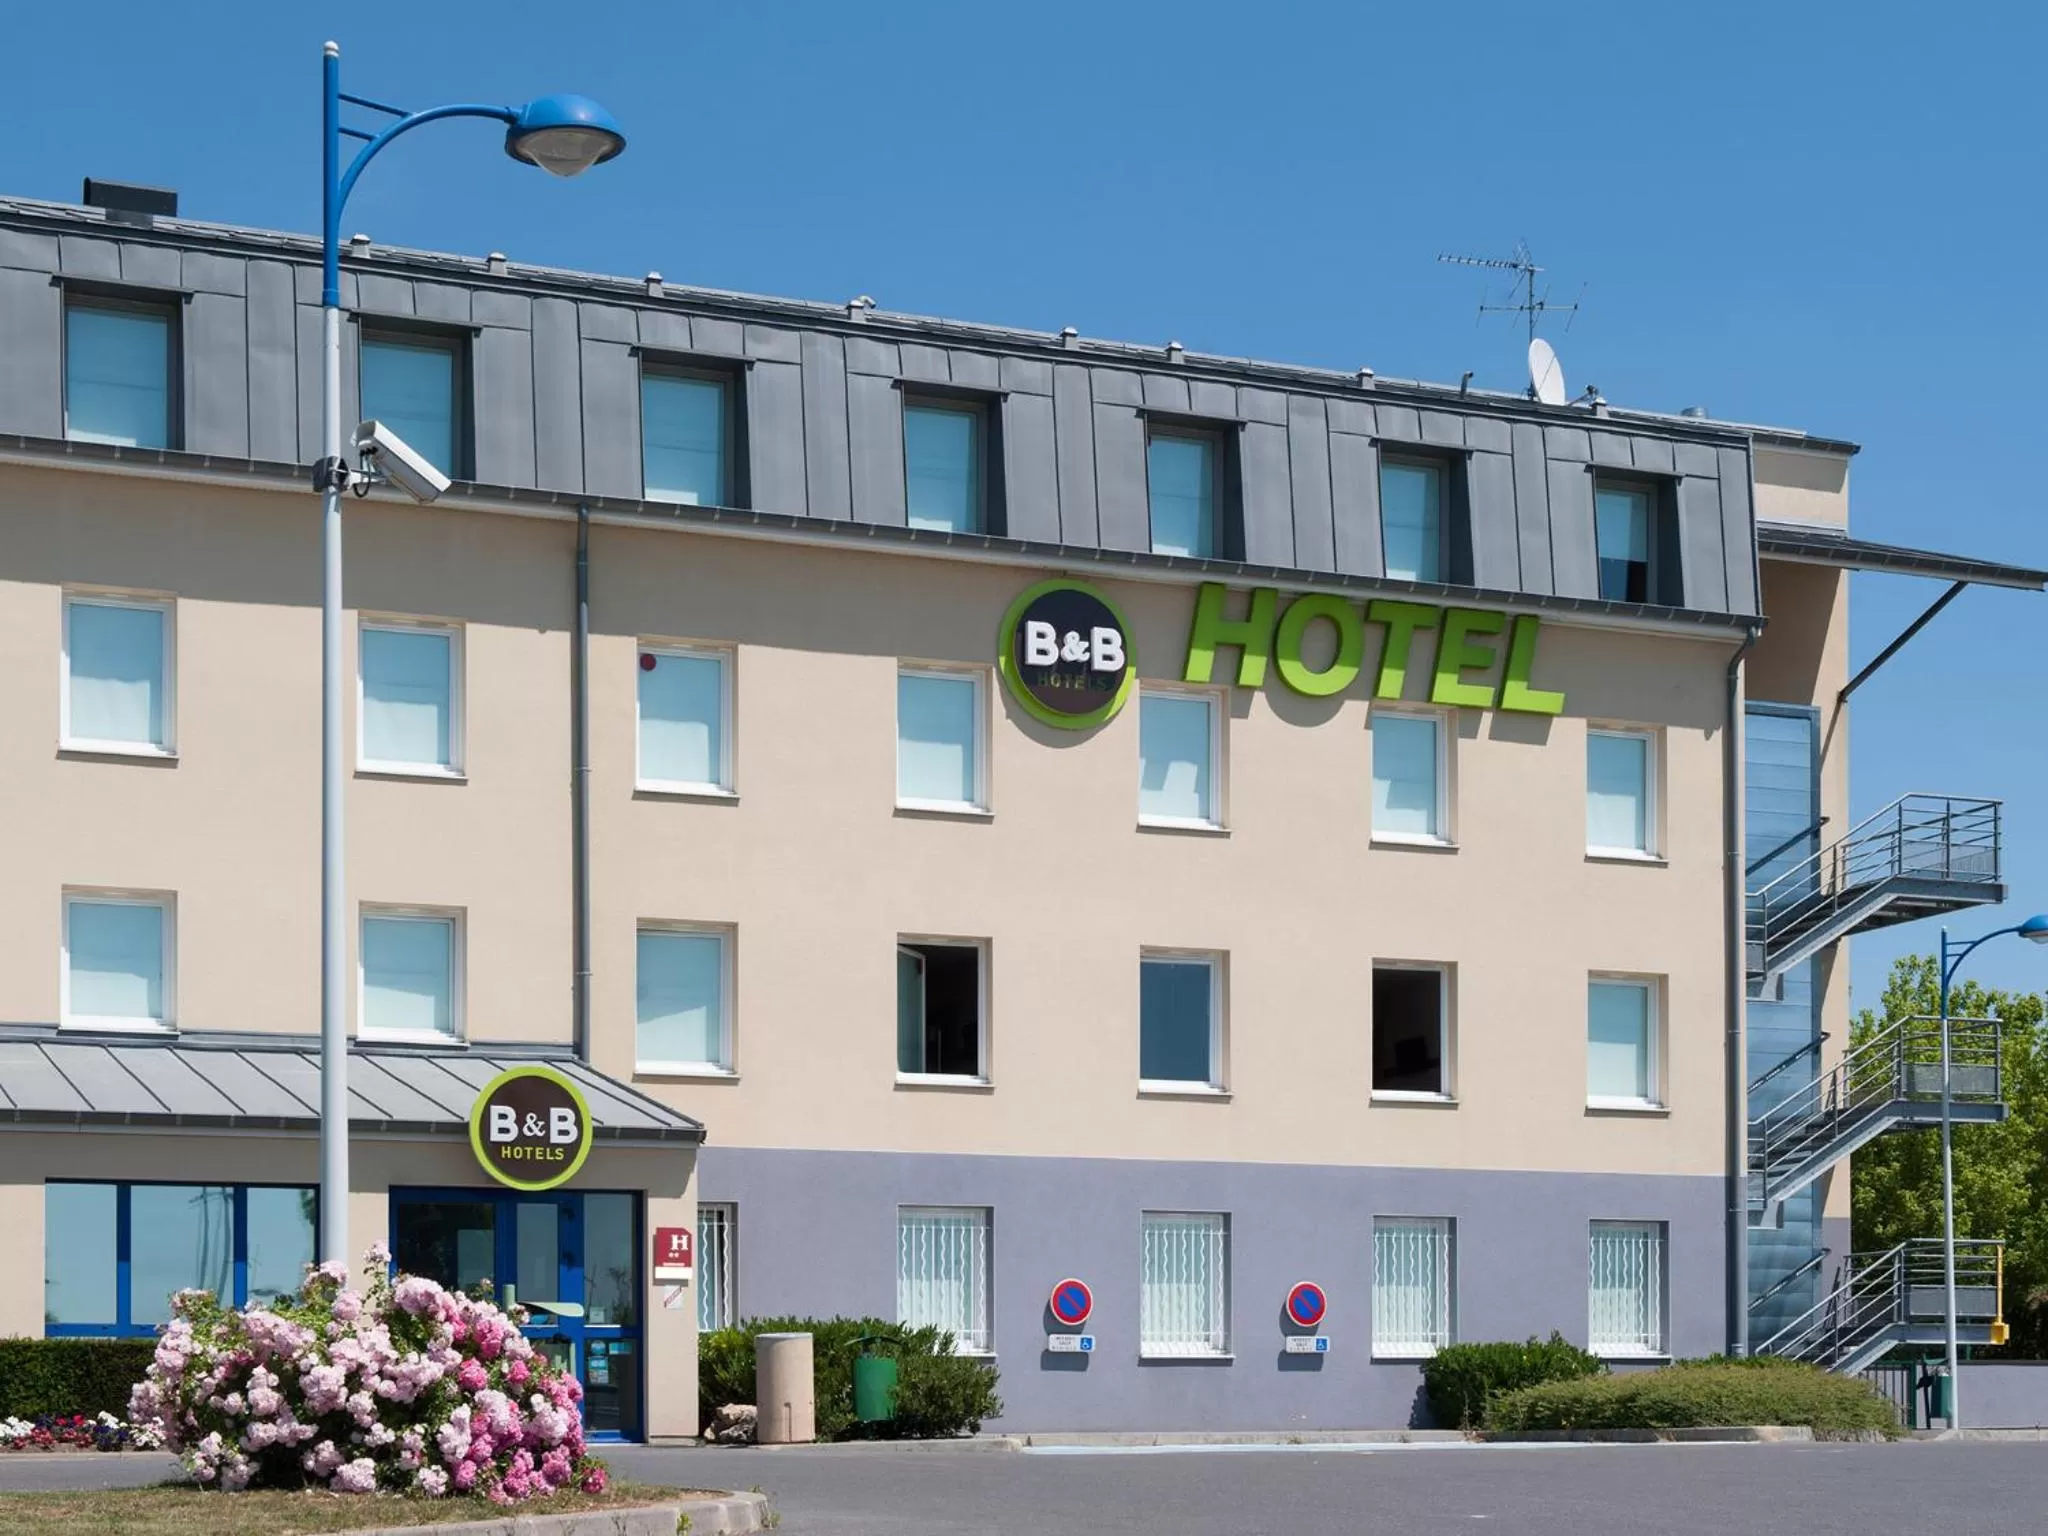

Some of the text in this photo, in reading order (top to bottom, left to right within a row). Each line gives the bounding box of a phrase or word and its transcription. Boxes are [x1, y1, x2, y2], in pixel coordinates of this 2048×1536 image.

[1025, 620, 1125, 672] B&B
[1184, 582, 1565, 714] HOTEL
[489, 1105, 578, 1144] B&B
[501, 1146, 564, 1160] HOTELS
[671, 1234, 689, 1250] H
